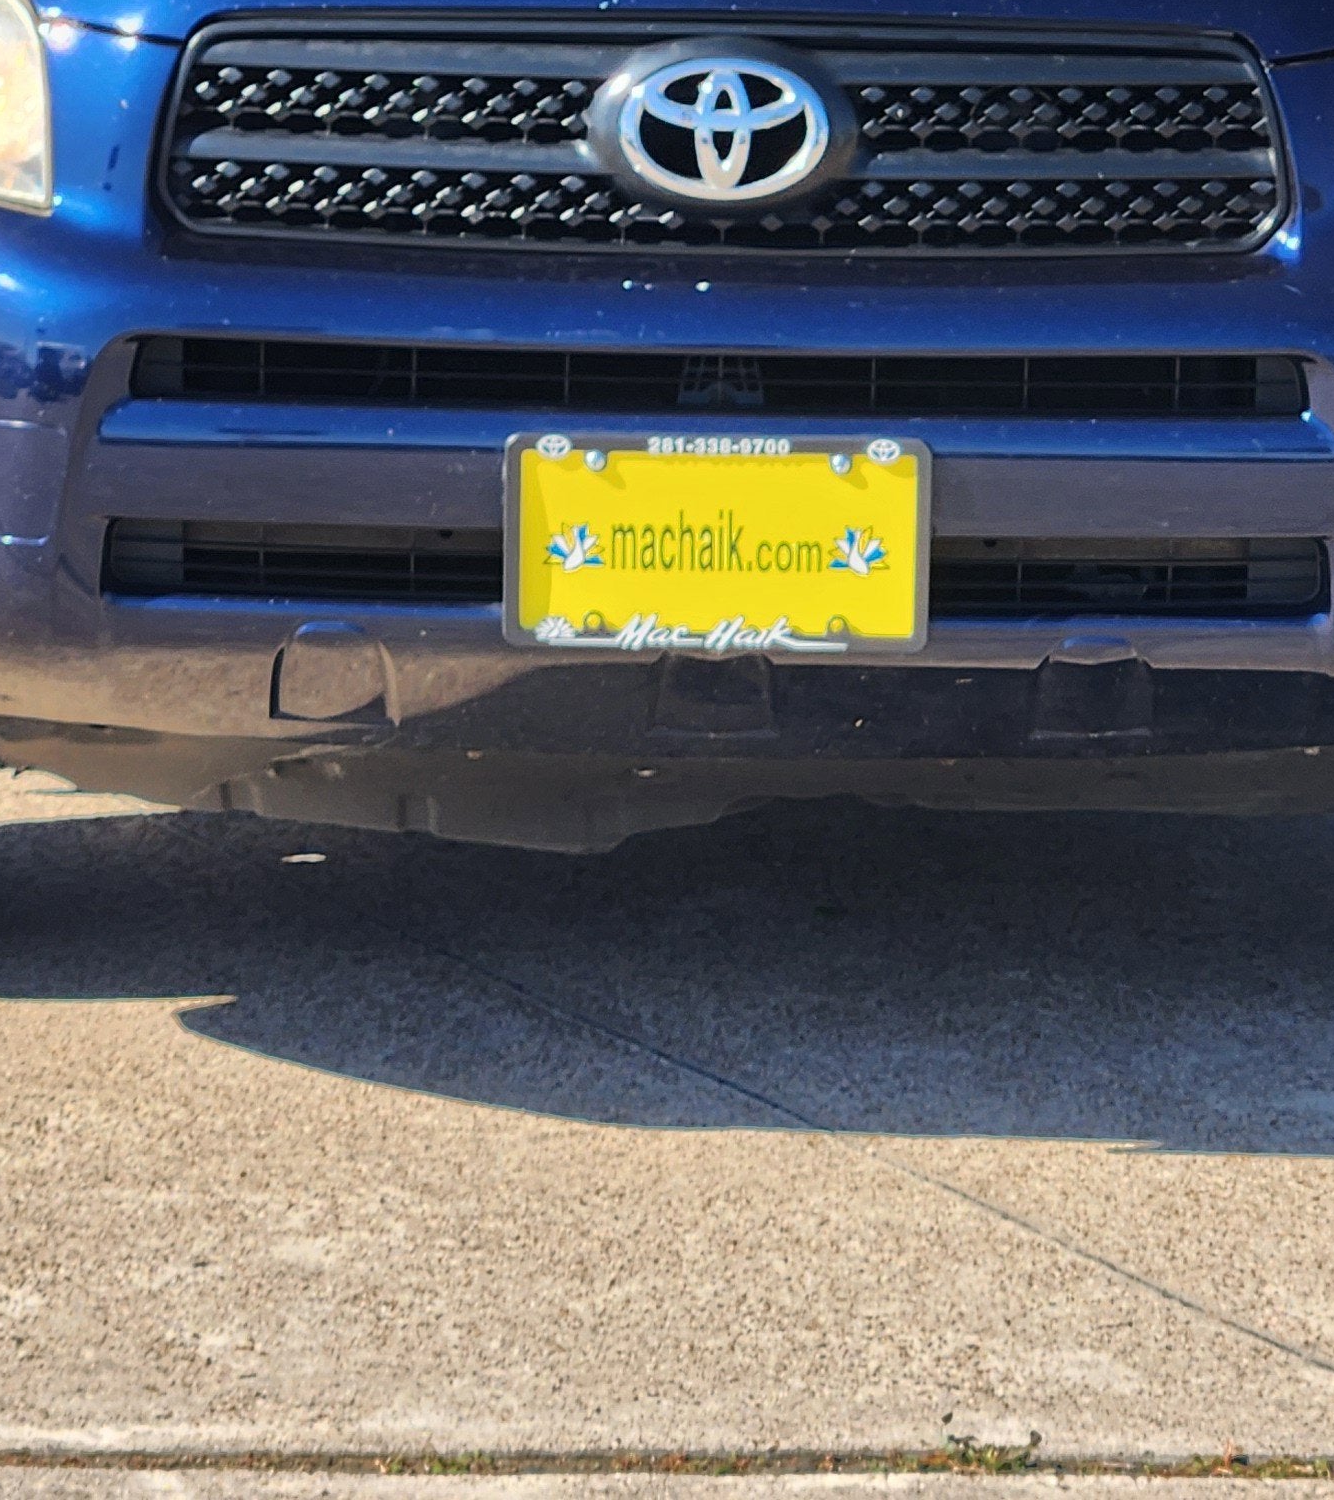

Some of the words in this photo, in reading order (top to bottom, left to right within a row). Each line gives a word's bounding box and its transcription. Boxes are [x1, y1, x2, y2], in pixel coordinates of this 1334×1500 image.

[611, 508, 823, 573] machaik.com
[616, 611, 695, 651] Mac
[704, 613, 795, 651] Haik
